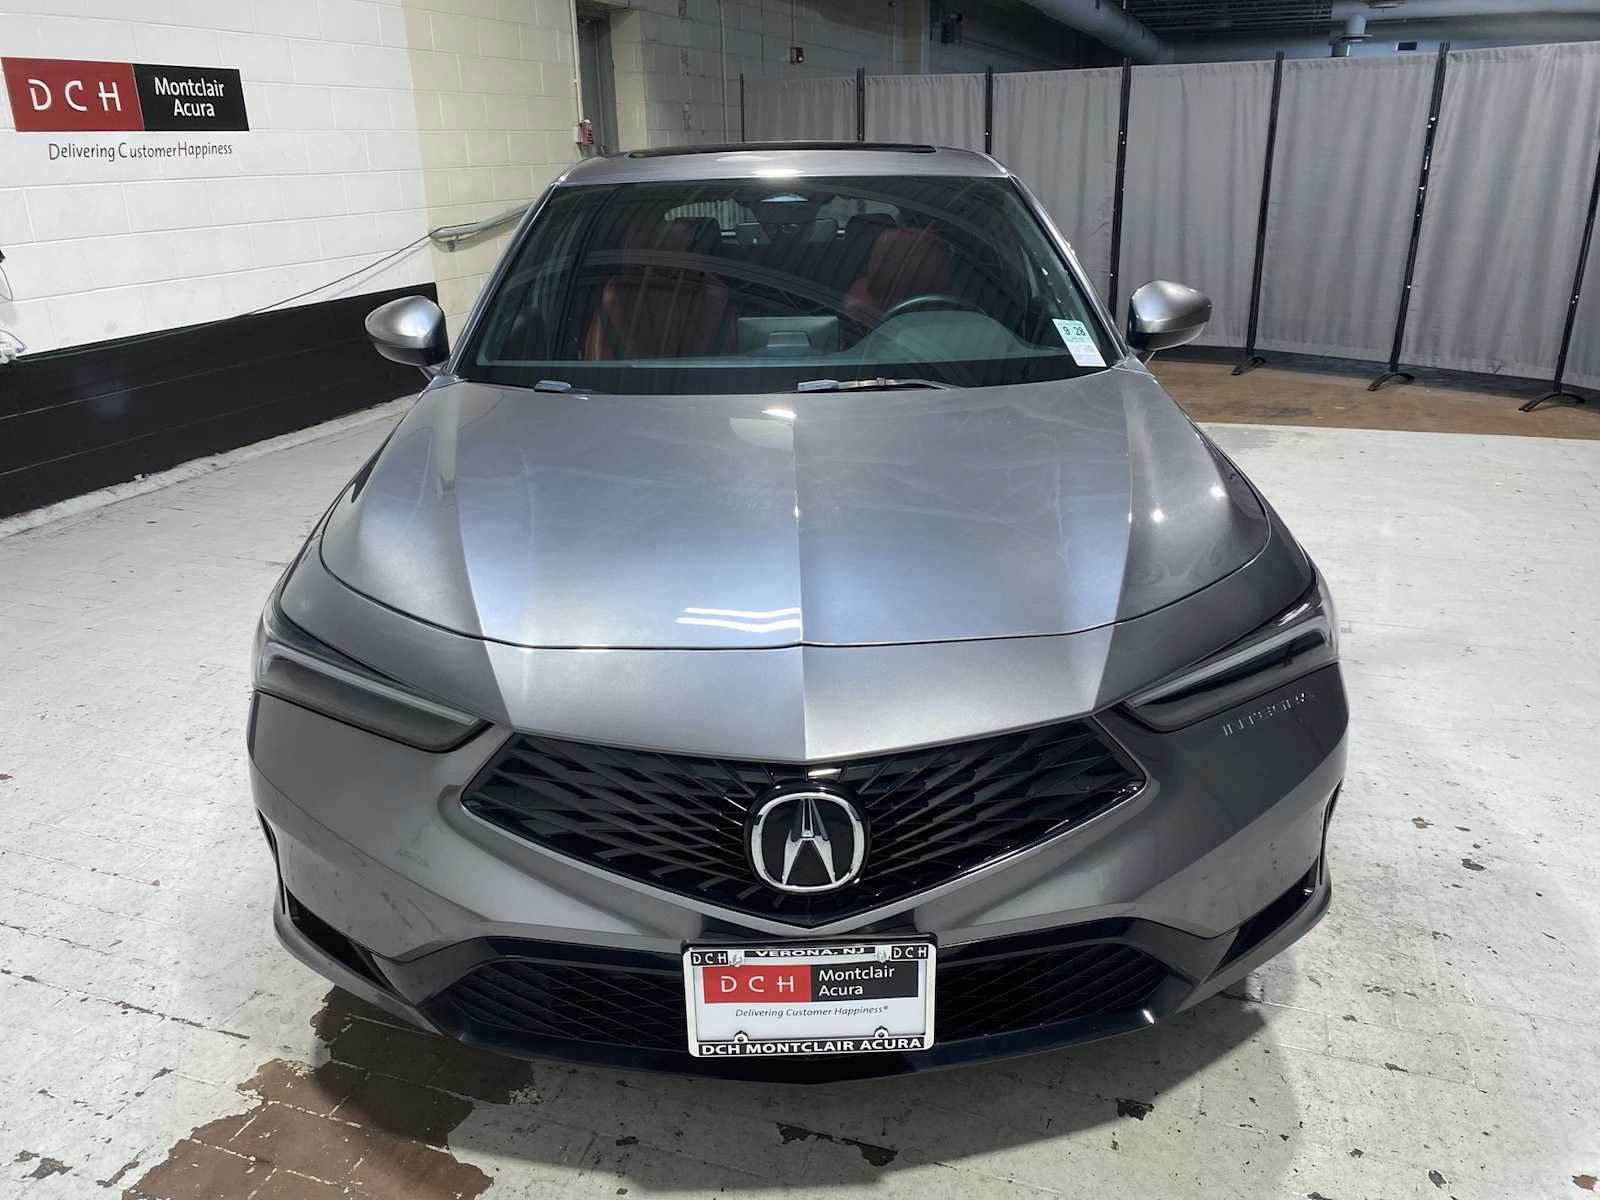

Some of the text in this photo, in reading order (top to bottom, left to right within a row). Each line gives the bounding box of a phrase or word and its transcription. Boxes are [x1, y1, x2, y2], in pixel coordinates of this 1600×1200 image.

[154, 76, 225, 97] Montclair
[174, 98, 215, 117] Acura
[49, 143, 115, 161] Delivering
[1062, 326, 1071, 336] 9
[843, 947, 865, 955] NJ
[893, 946, 927, 958] DCH
[692, 953, 727, 965] DCH
[818, 966, 896, 982] Montclair
[721, 976, 794, 993] DCH
[818, 984, 864, 997] Acura
[735, 1008, 784, 1018] Delivering
[786, 1007, 832, 1017] Customer
[702, 1037, 922, 1055] DCH MONTCLAIR ACURA
